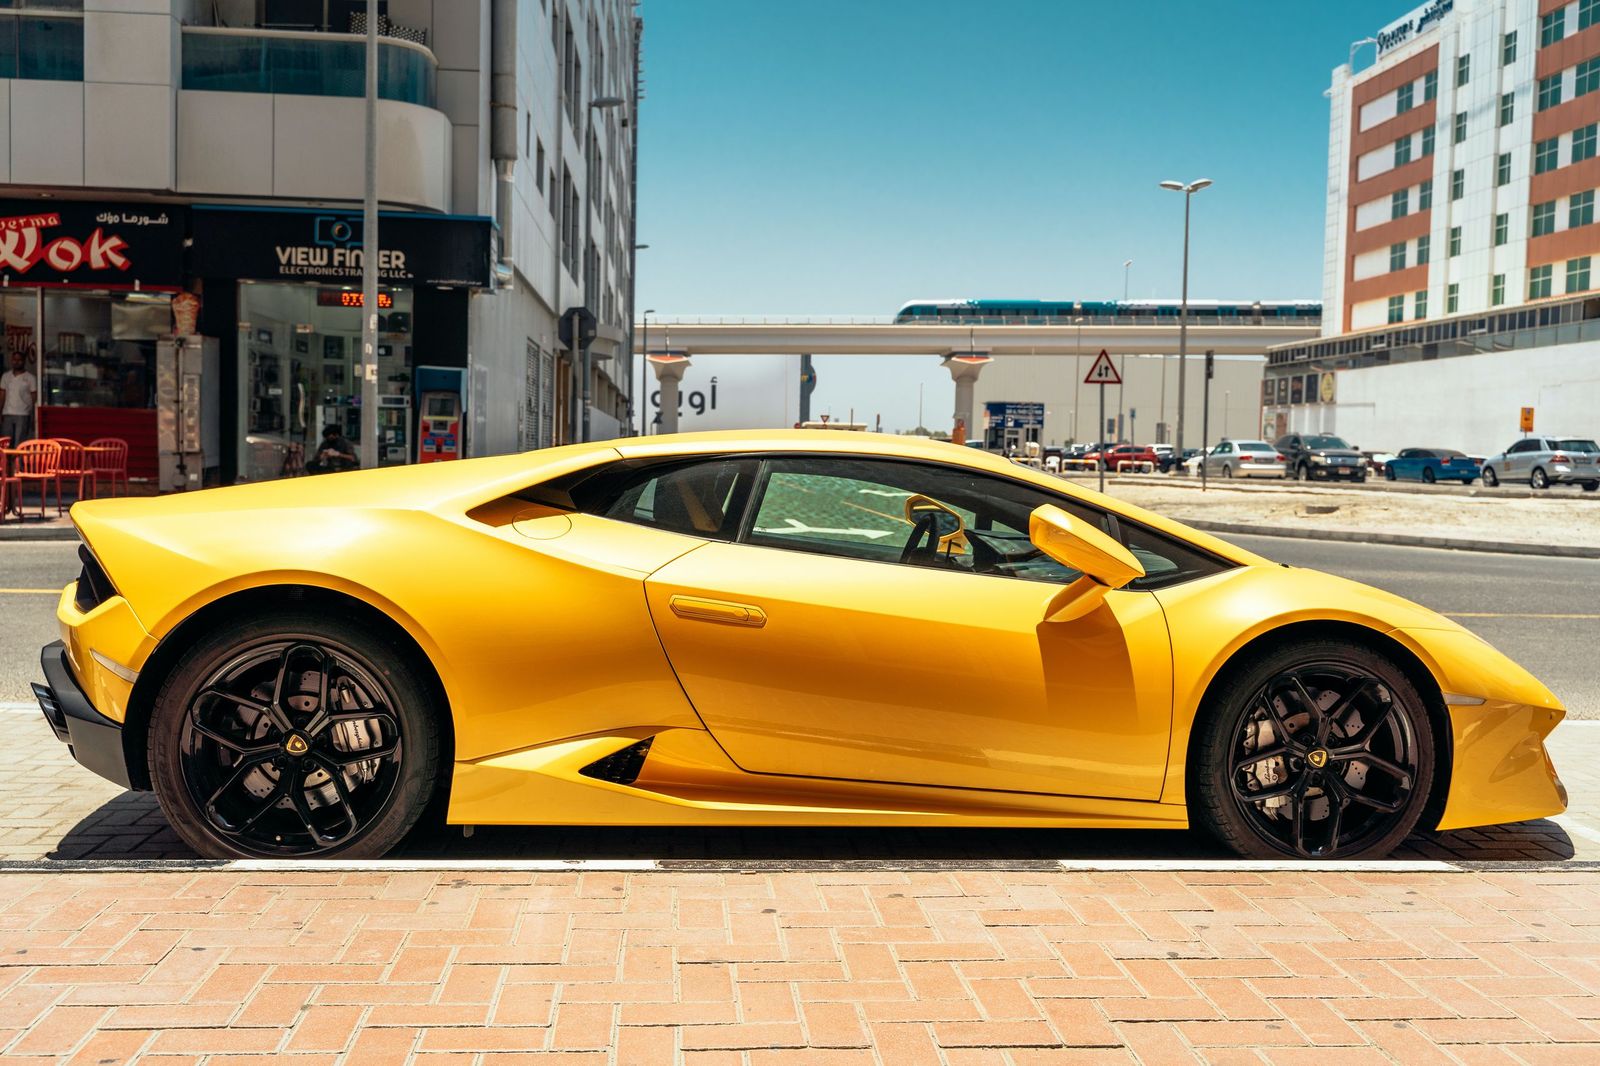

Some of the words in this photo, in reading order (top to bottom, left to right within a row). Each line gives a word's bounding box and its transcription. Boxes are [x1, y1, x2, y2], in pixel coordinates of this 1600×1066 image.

[275, 246, 328, 266] VIEW
[333, 248, 405, 269] FINER
[279, 266, 344, 276] ELECTRONICS
[345, 268, 388, 278] TRANG
[390, 269, 406, 278] LLC
